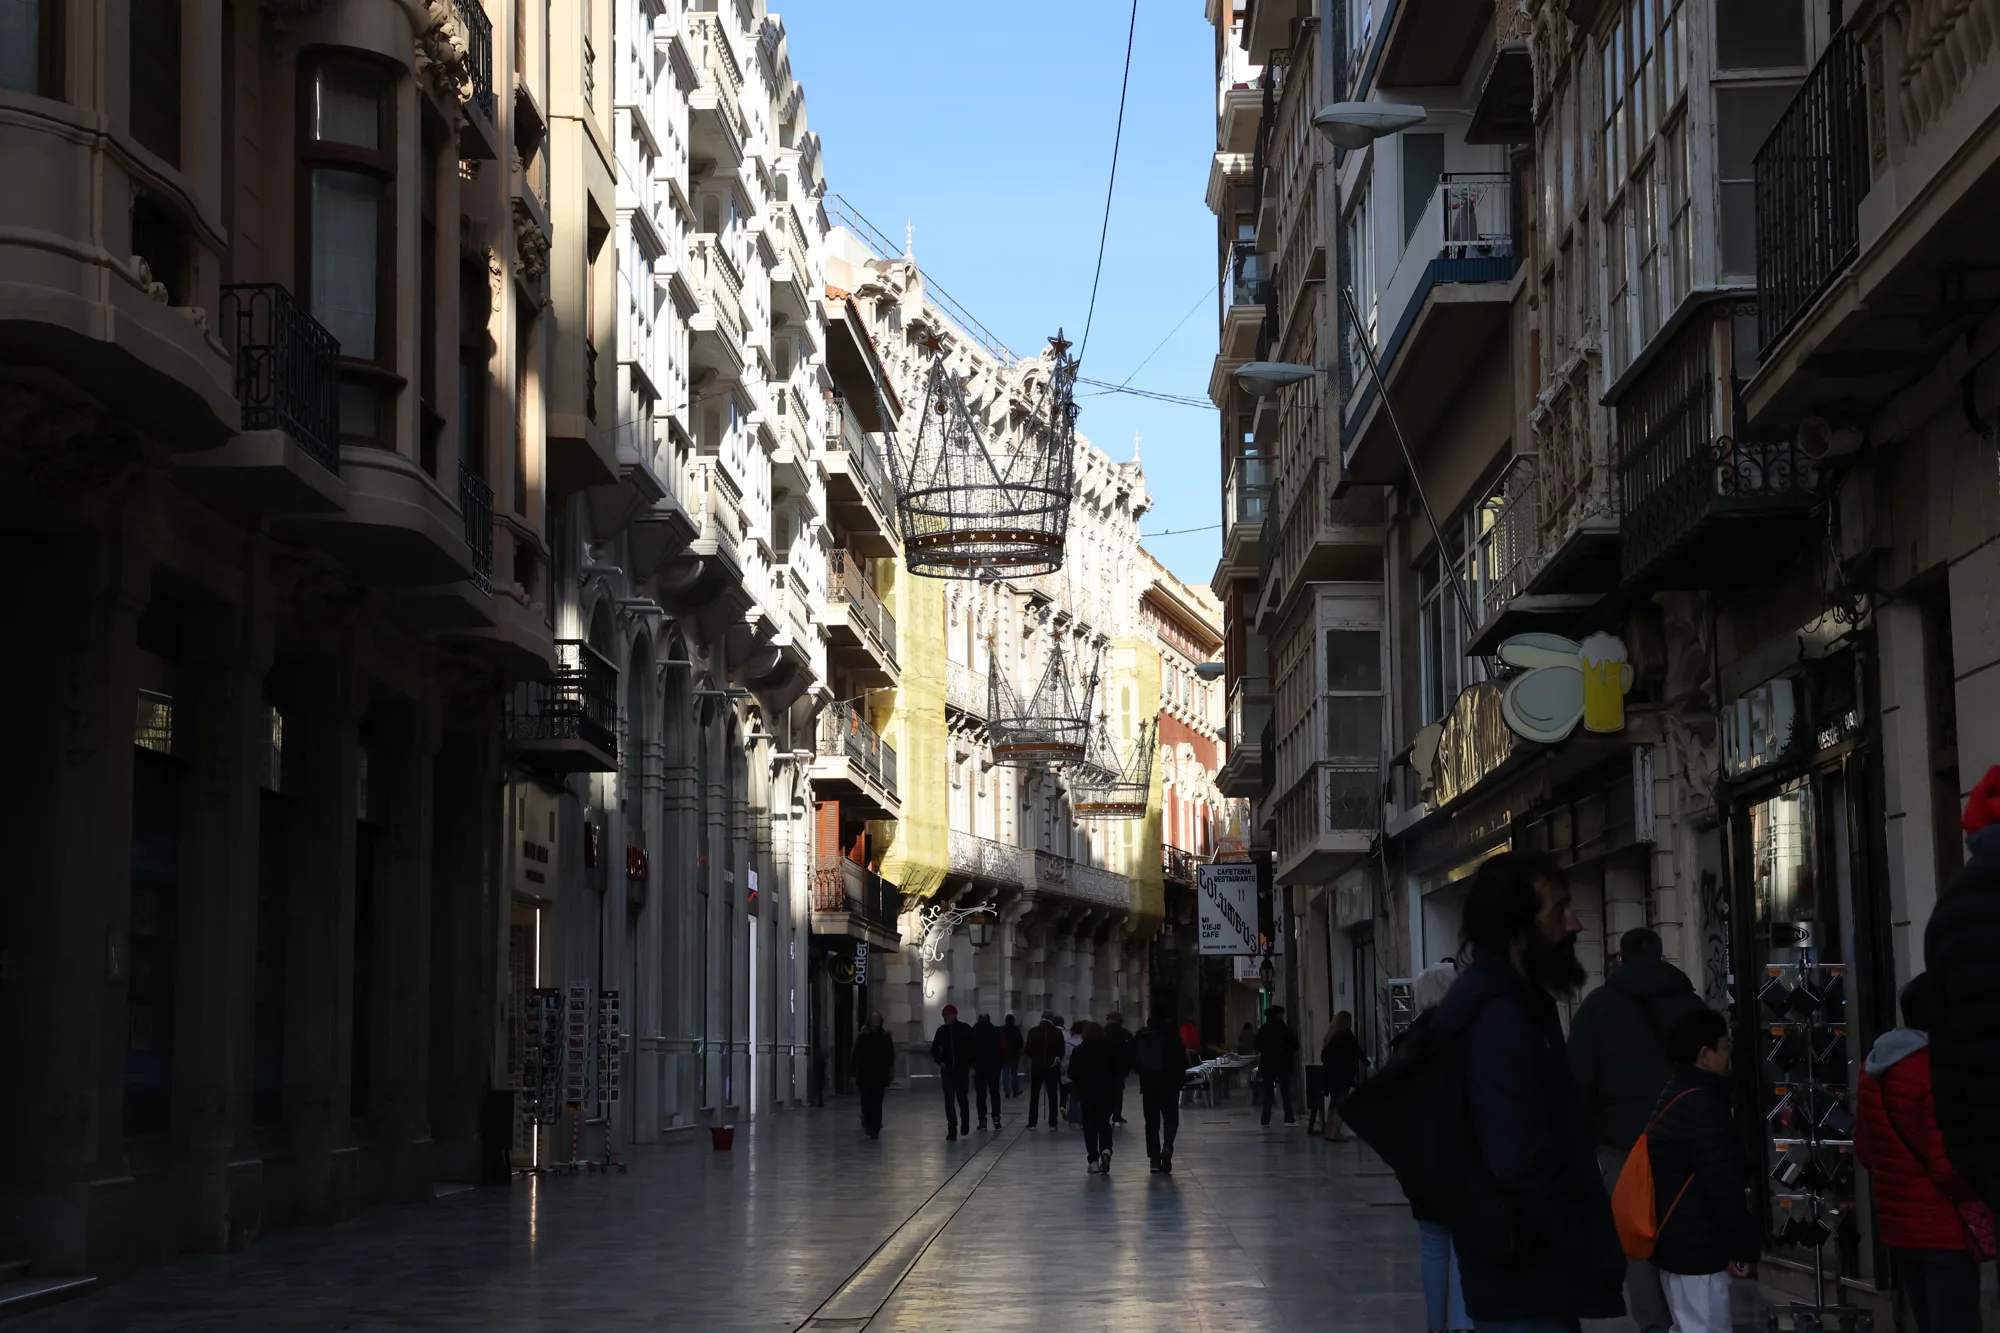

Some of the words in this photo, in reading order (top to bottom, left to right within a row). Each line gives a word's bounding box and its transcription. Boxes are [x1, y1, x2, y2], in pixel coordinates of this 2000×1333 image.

[1217, 868, 1252, 876] CAFETERIA
[1199, 867, 1257, 952] COLUMBUS
[855, 941, 867, 985] outlet
